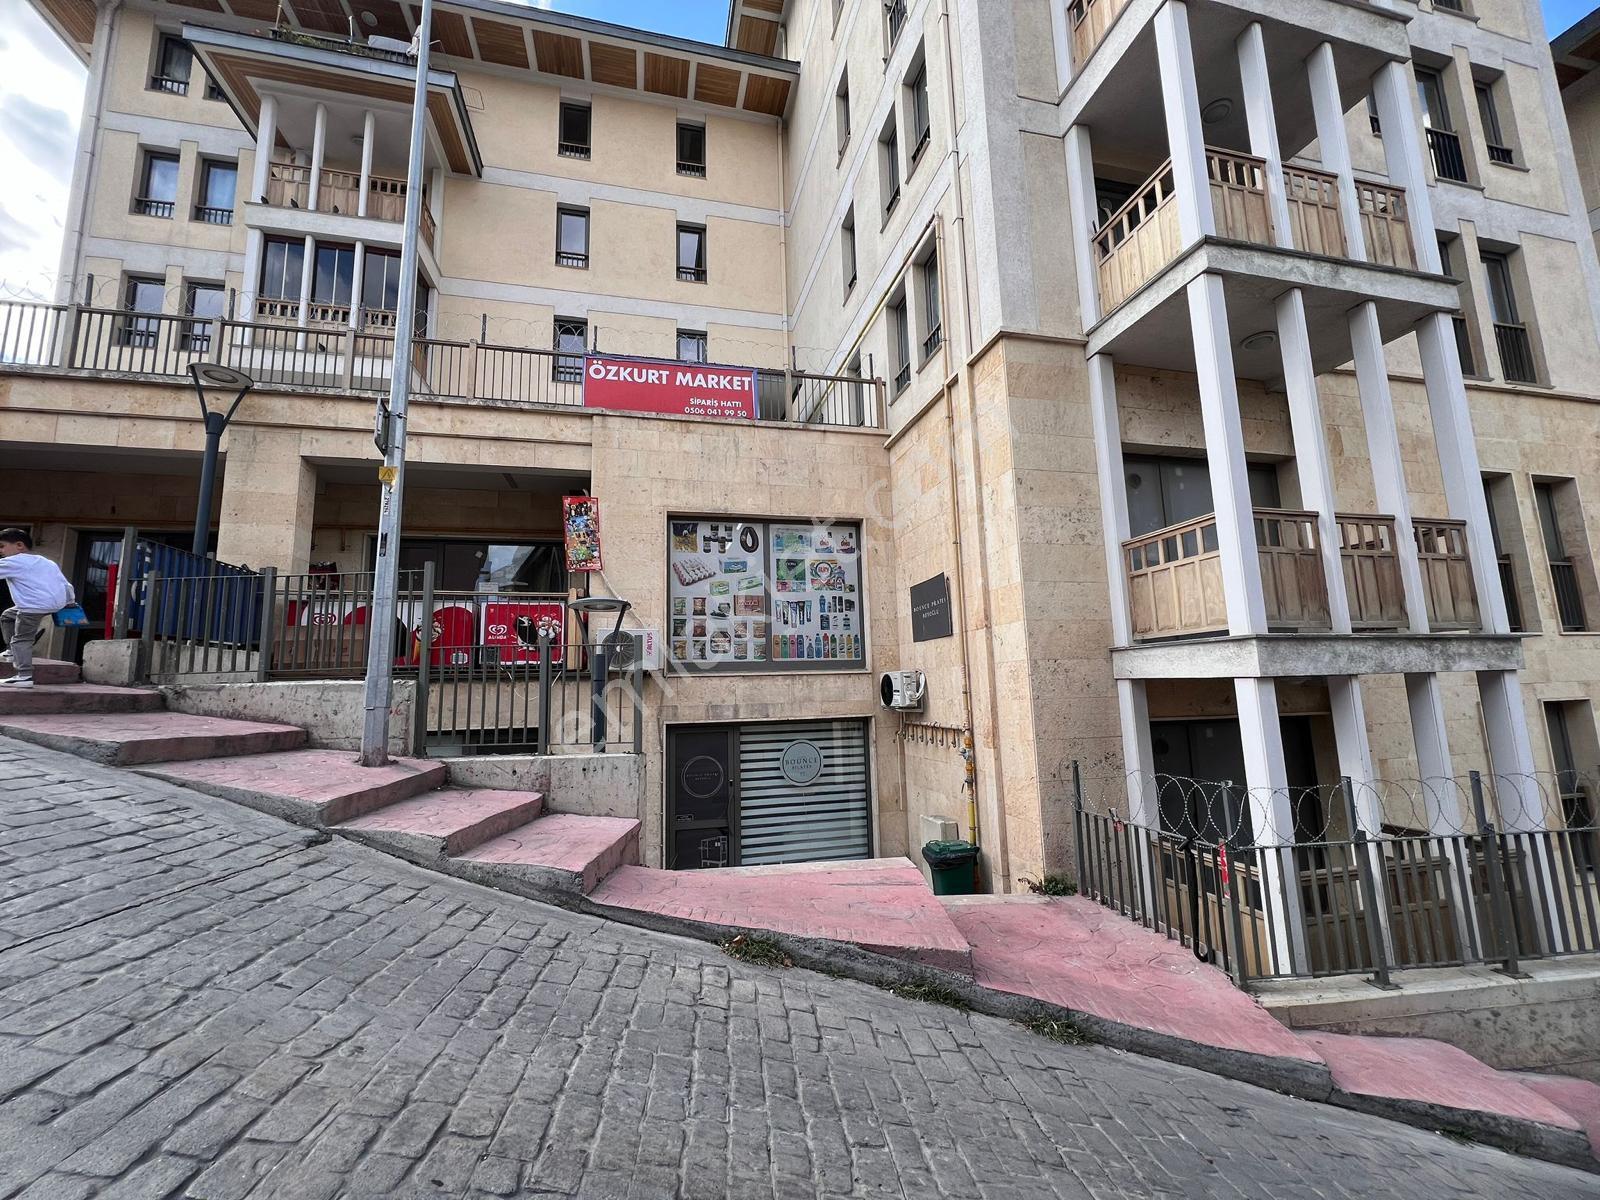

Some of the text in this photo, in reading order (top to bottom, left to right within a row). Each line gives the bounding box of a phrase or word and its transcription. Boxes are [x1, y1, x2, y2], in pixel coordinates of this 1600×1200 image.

[589, 359, 752, 391] ÖZKURT MARKET
[690, 397, 742, 408] SİPARİŞ HATTI
[684, 407, 747, 418] 0506 041 99 50
[785, 757, 817, 765] BOUNCE
